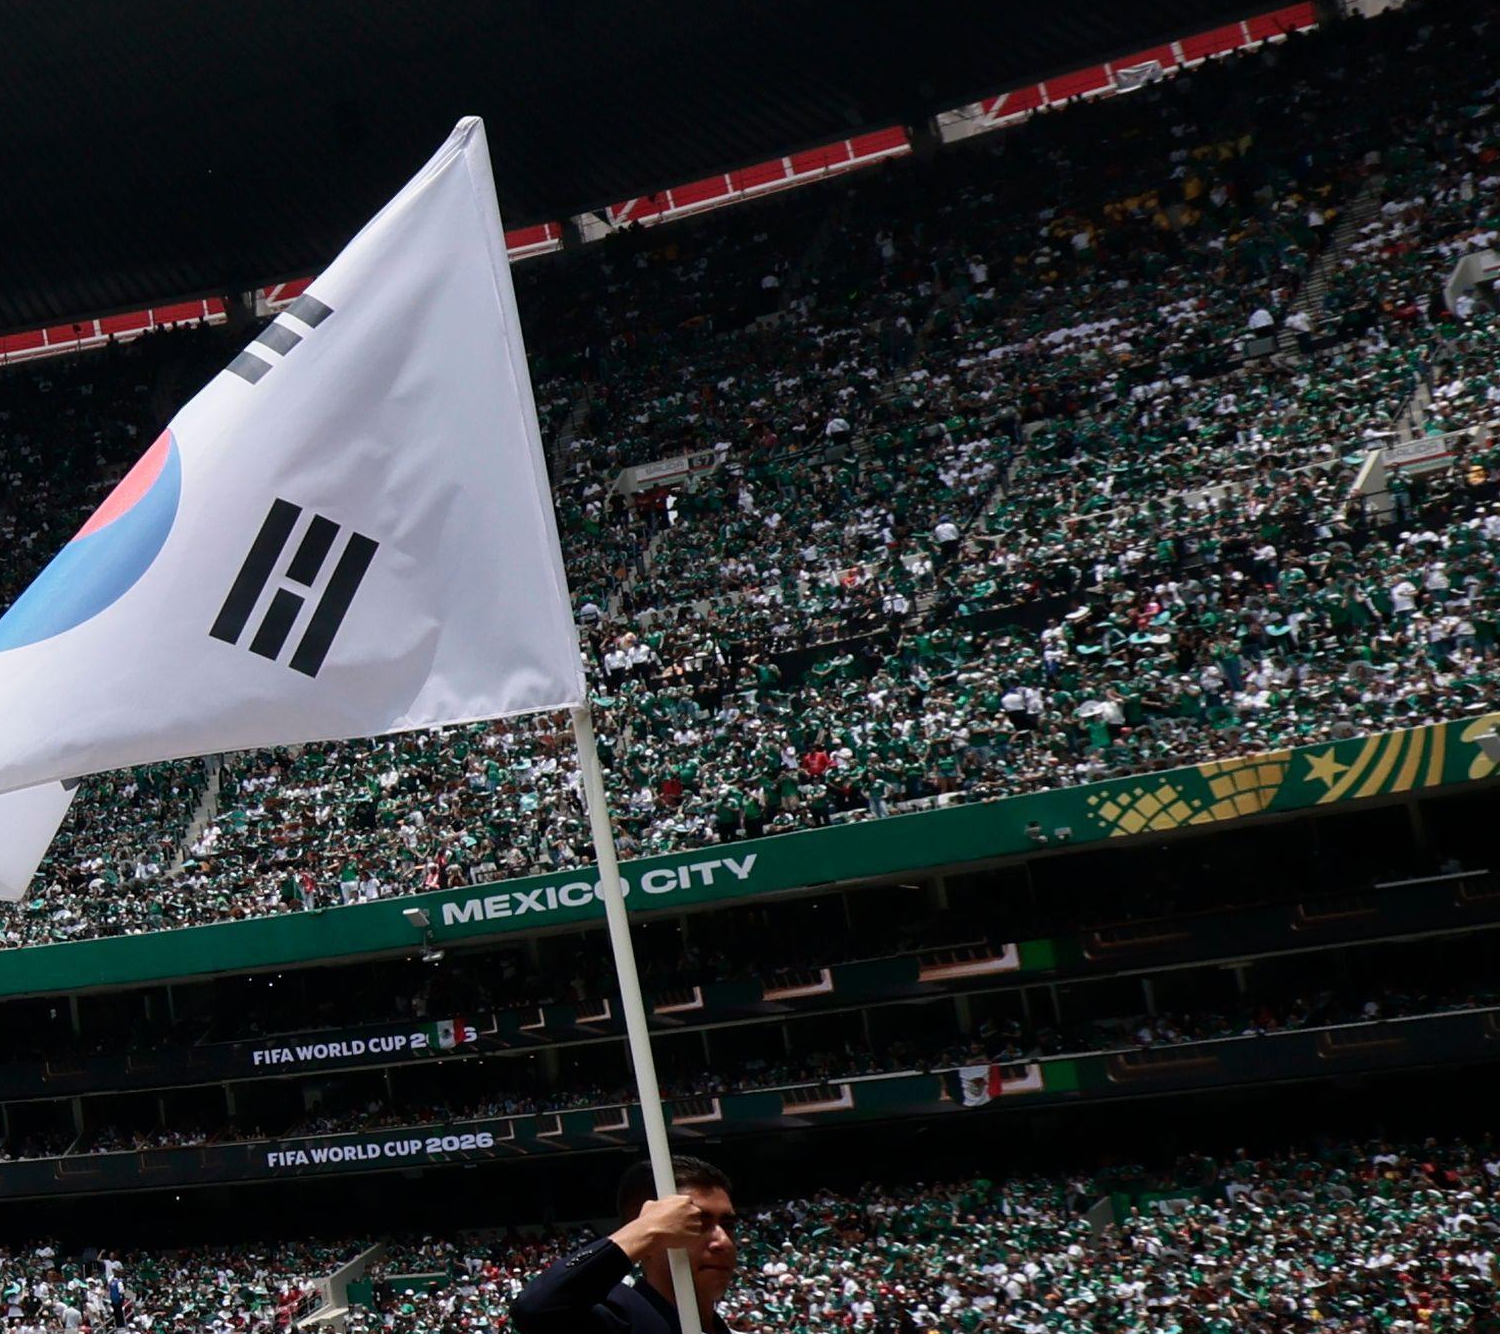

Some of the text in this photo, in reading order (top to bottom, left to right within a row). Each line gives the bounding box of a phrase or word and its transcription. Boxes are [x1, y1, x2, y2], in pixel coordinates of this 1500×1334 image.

[640, 854, 757, 894] CITY
[253, 1026, 477, 1065] FIFA WORLD CUP 26
[266, 1132, 494, 1167] FIFA WORLD CUP 2026
